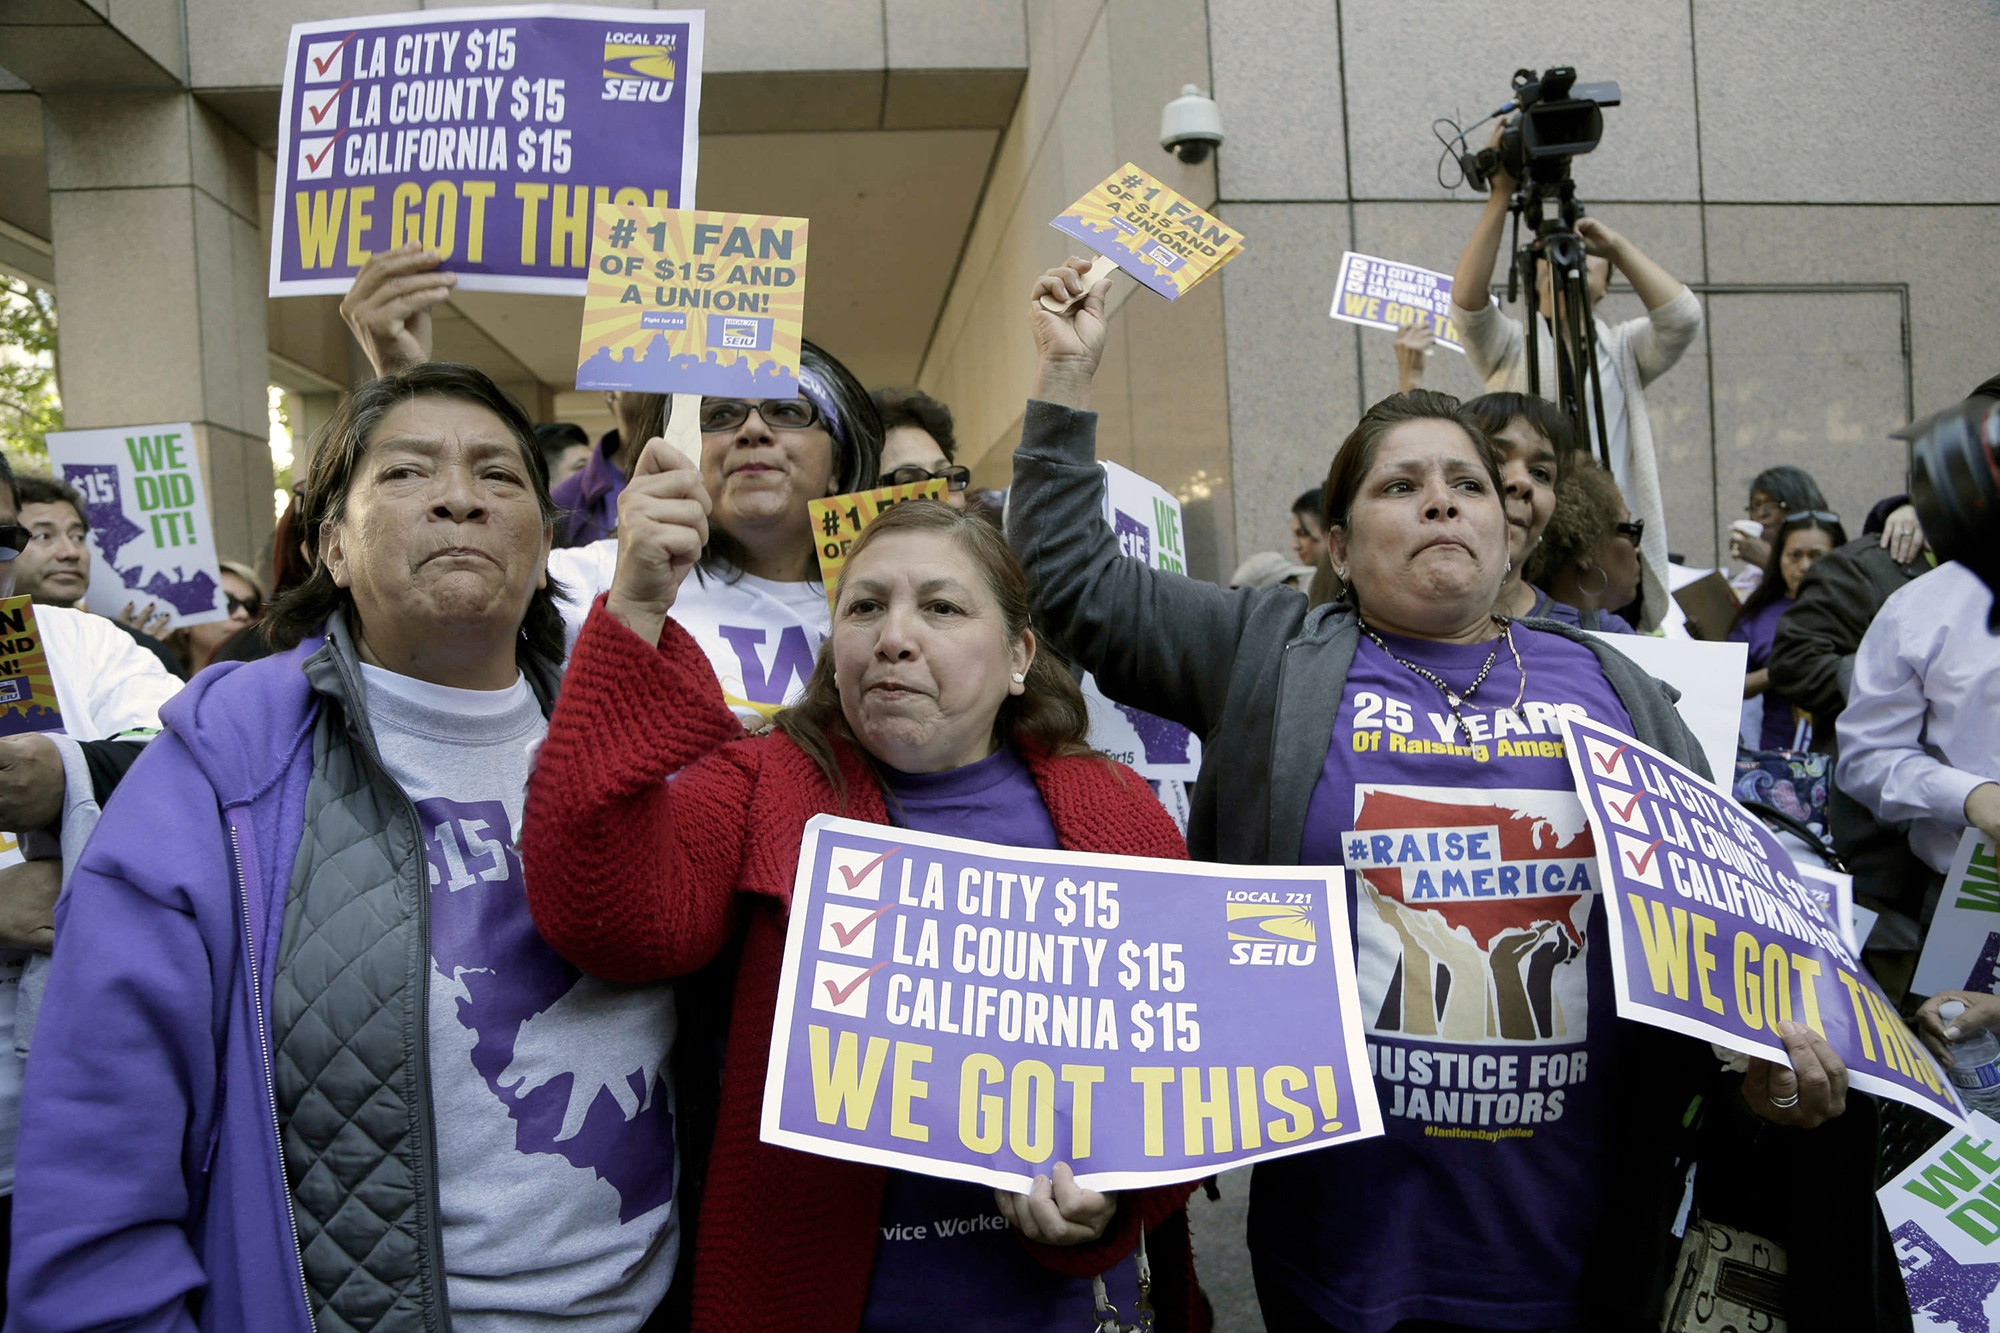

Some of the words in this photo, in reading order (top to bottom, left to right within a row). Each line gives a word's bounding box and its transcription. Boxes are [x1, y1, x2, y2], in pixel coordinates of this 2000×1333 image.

[354, 37, 386, 80] LA
[394, 31, 461, 76] CITY
[465, 28, 517, 72] $15
[606, 32, 652, 45] LOCAL
[655, 33, 677, 45] 721
[349, 84, 381, 128] LA
[389, 77, 504, 125] COUNTY
[511, 77, 565, 123] $15
[602, 79, 673, 102] SEIU
[344, 126, 508, 177] CALIFORNIA
[517, 127, 572, 174] $15
[296, 186, 375, 269] WE
[390, 180, 496, 265] GOT
[1107, 184, 1135, 202] OF
[1135, 201, 1173, 228] $15
[1174, 230, 1217, 257] AND
[1107, 202, 1122, 213] A
[1126, 212, 1194, 258] UNION!
[1121, 175, 1160, 201] #1
[1165, 201, 1230, 247] FAN
[608, 219, 667, 252] #1
[693, 223, 793, 260] FAN
[600, 255, 644, 277] OF
[654, 258, 715, 282] $15
[727, 265, 796, 287] AND
[1370, 263, 1386, 274] LA
[620, 284, 642, 304] A
[655, 287, 770, 313] UNION!
[1344, 292, 1381, 320] WE
[724, 337, 755, 346] SEIU
[125, 433, 187, 472] WE
[71, 472, 114, 504] $15
[134, 473, 195, 511] DID
[150, 512, 197, 548] IT!
[822, 506, 861, 537] #1
[1153, 496, 1181, 557] WE
[1353, 692, 1413, 733] 25
[1352, 731, 1381, 753] Of
[1633, 755, 1677, 804] LA
[1669, 774, 1730, 832] CITY
[1723, 807, 1768, 860] $15
[425, 819, 510, 893] 15
[1348, 831, 1492, 865] #RAISE
[1650, 800, 1695, 852] LA
[1691, 818, 1784, 898] COUNTY
[1776, 871, 1825, 923] $15
[899, 858, 944, 911] LA
[957, 867, 1045, 923] CITY
[1054, 877, 1120, 929] $15
[1226, 890, 1279, 904] LOCAL
[1286, 893, 1312, 904] 721
[1411, 862, 1592, 899] AMERICA
[1668, 851, 1825, 949] CALIFORNIA
[893, 914, 939, 969] LA
[952, 923, 1107, 988] COUNTY
[1118, 939, 1186, 992] $15
[1229, 942, 1317, 966] SEIU
[1627, 892, 1725, 1016] WE
[1733, 931, 1828, 1043] GOT
[886, 974, 1119, 1051] CALIFORNIA
[1131, 999, 1200, 1052] $15
[1529, 1051, 1588, 1088] FOR
[808, 1024, 933, 1143] WE
[958, 1052, 1105, 1163] GOT
[1131, 1064, 1344, 1157] THIS!
[1390, 1085, 1565, 1126] JANITORS
[1902, 1134, 2000, 1210] WE
[880, 1223, 927, 1241] vice
